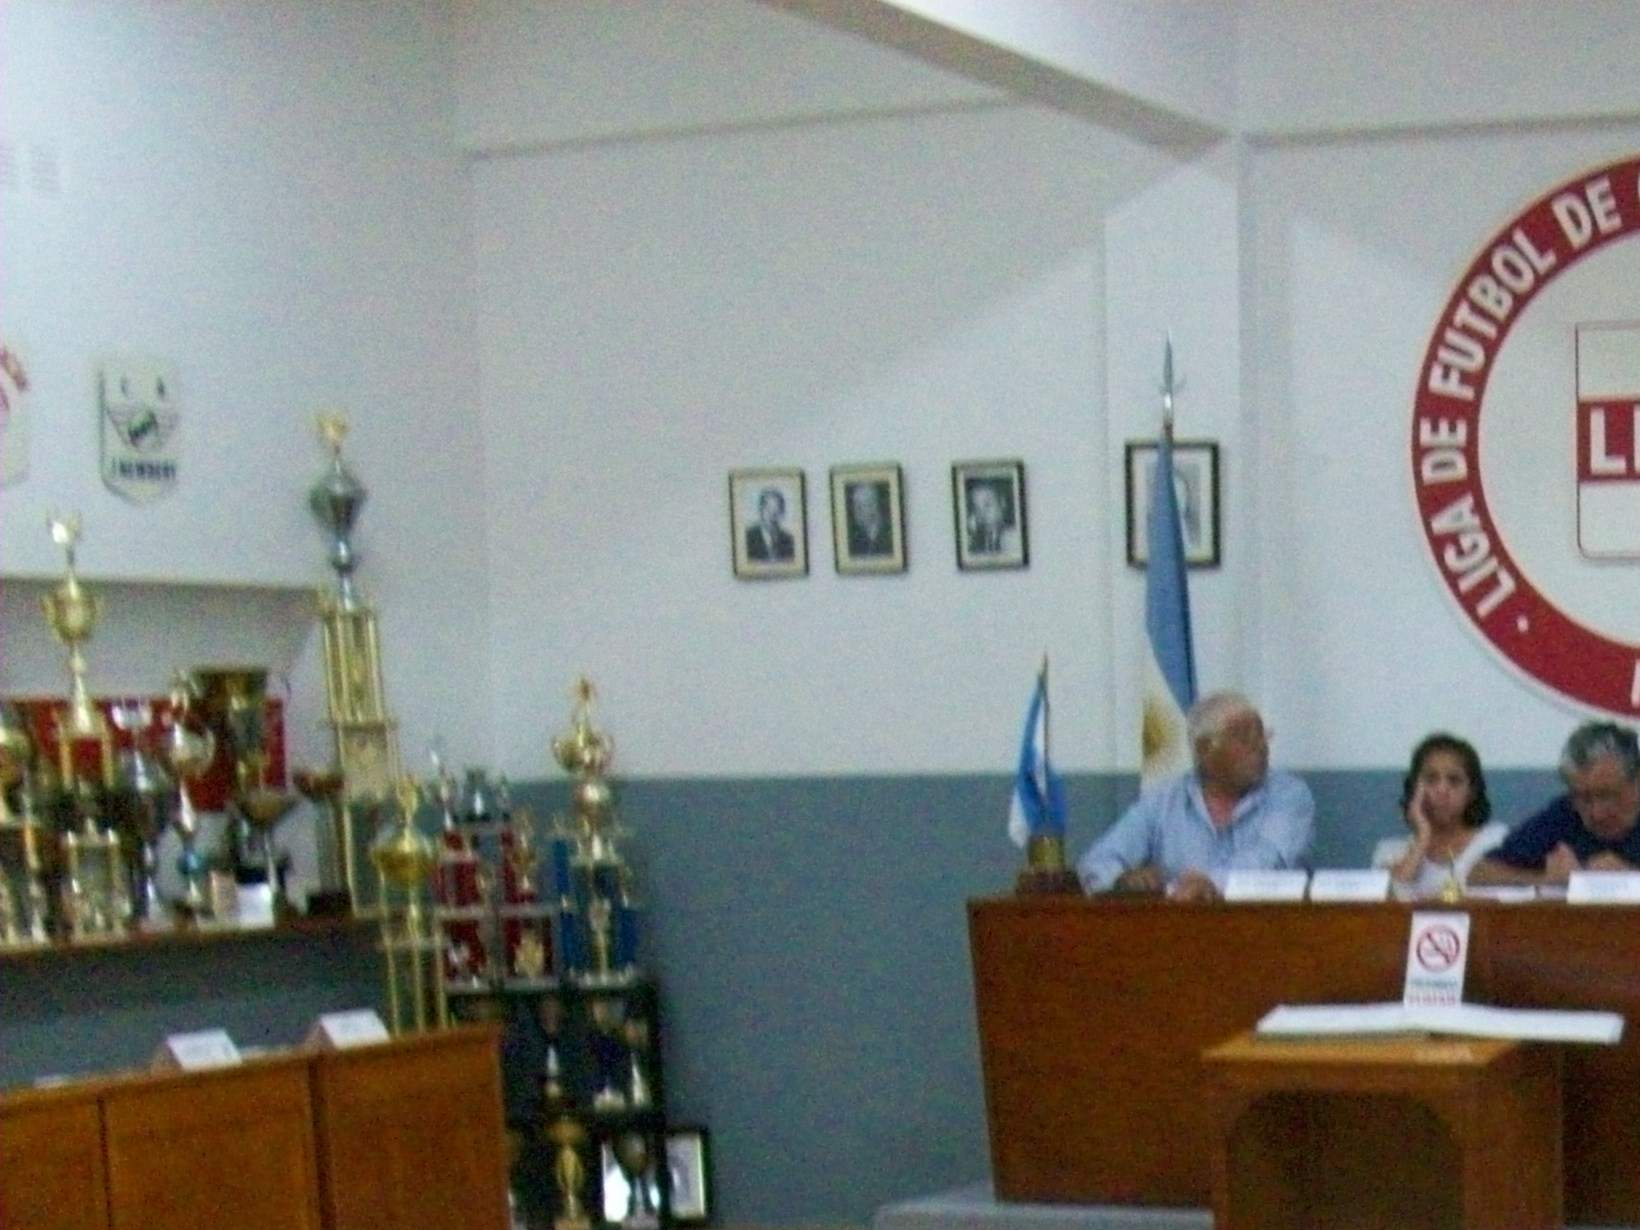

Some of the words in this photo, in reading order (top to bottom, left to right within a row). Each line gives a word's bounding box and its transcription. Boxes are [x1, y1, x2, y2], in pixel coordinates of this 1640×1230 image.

[1553, 178, 1622, 245] DE
[1428, 228, 1556, 400] FUTBOL
[1419, 416, 1468, 485] DE
[1431, 494, 1516, 618] LIGA
